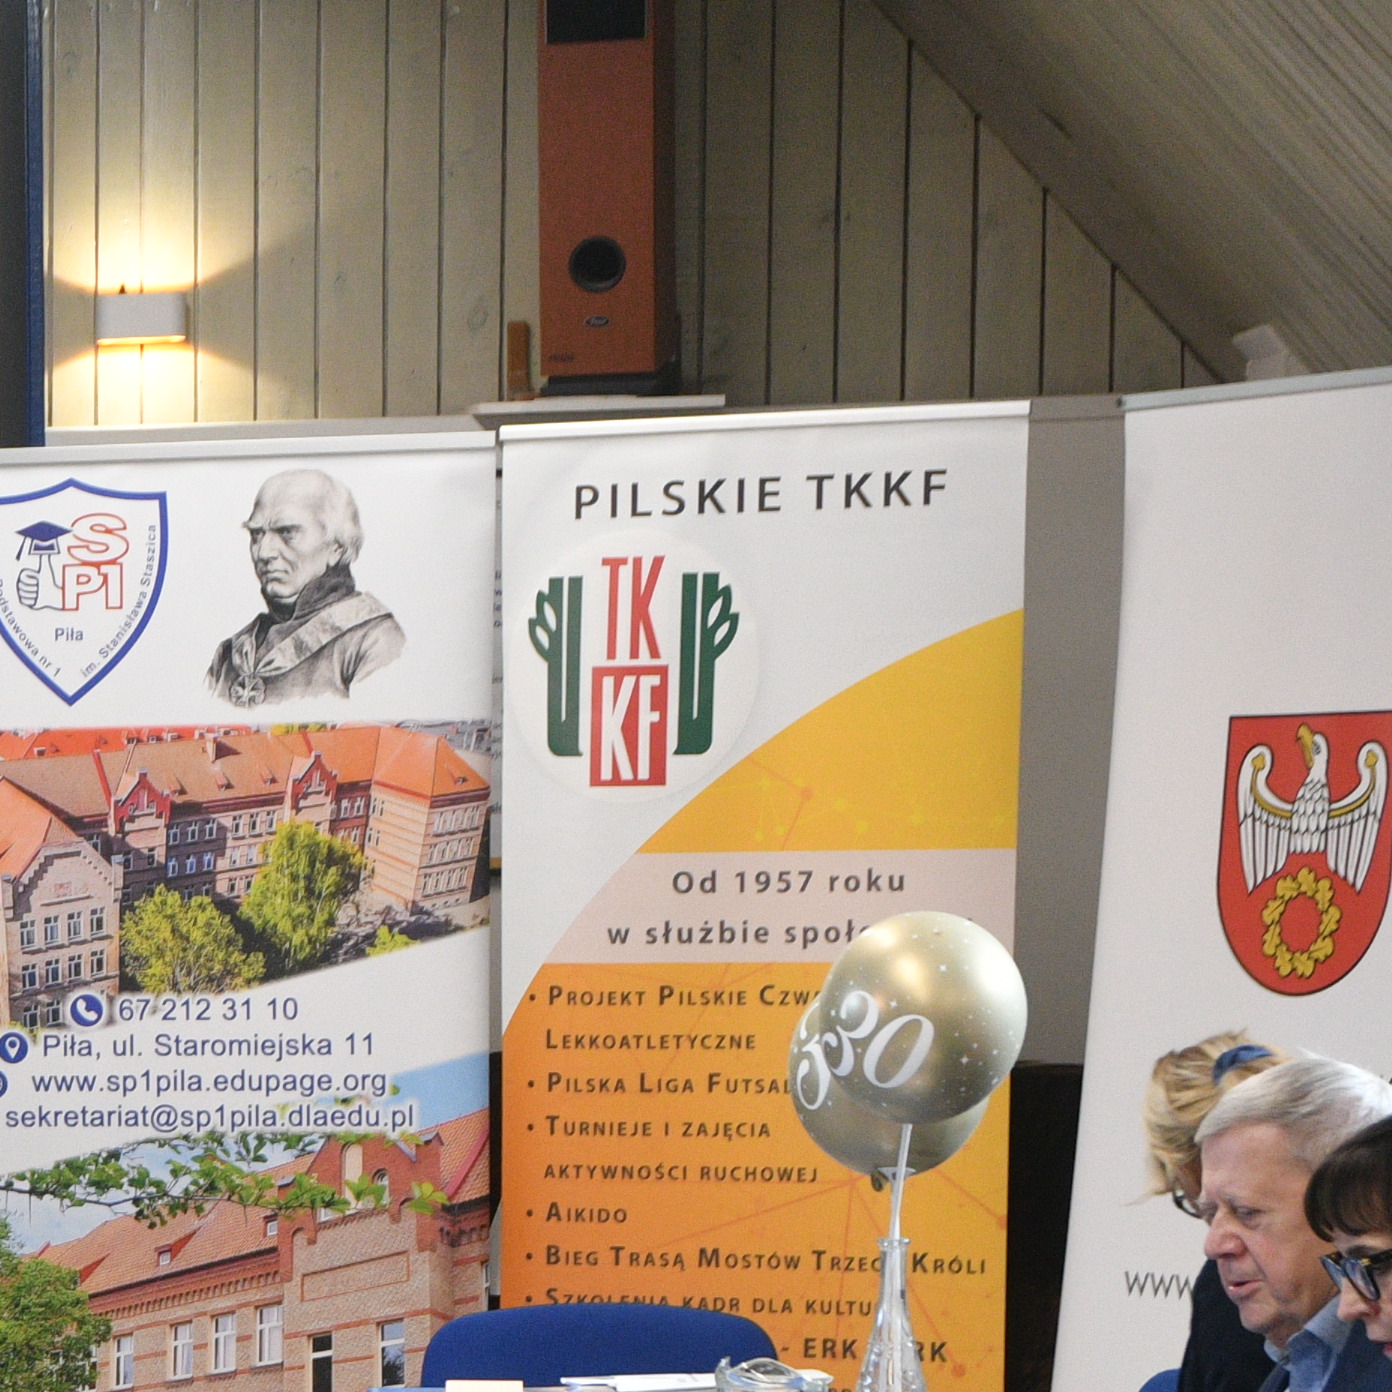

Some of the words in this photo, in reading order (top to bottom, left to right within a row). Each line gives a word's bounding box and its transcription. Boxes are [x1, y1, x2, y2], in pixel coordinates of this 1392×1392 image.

[574, 476, 783, 520] PILSKIE
[806, 469, 949, 510] TKKF
[67, 513, 130, 564] S
[81, 662, 101, 678] im.
[99, 591, 147, 658] Stanisława
[140, 525, 156, 587] Staszica
[601, 555, 666, 660] TK
[55, 627, 84, 642] Piła
[39, 655, 52, 669] nr
[600, 673, 662, 782] KF
[672, 870, 717, 894] Od
[735, 870, 813, 893] 1957
[828, 867, 907, 893] roku
[607, 927, 630, 944] w
[646, 920, 769, 944] służbie
[785, 919, 871, 949] społ
[119, 999, 151, 1021] 67
[161, 998, 211, 1021] 212
[222, 998, 251, 1020] 31
[268, 997, 299, 1020] 10
[549, 985, 646, 1006] PROJEKT
[659, 985, 747, 1006] PILSKIE
[759, 985, 822, 1006] CZW
[43, 1035, 101, 1060] Piła,
[113, 1034, 142, 1057] ul.
[154, 1033, 333, 1062] Staromiejska
[345, 1033, 374, 1056] 11
[546, 1029, 756, 1050] LEKKOATLETYCZNE
[821, 990, 935, 1089] 30
[31, 1070, 387, 1097] www.sp1pila.edupage.org
[547, 1072, 626, 1093] PILSKA
[639, 1072, 694, 1093] LIGA
[6, 1104, 414, 1133] sekretariat@sp1pila.dlaedu.pl
[546, 1115, 652, 1137] TURNIEJE
[544, 1162, 688, 1180] AKTYWNOŚCI
[700, 1166, 818, 1183] RUCHOWEJ
[546, 1202, 628, 1223] AIKIDO
[546, 1245, 599, 1266] BIEG
[610, 1246, 686, 1271] TRASĄ
[698, 1247, 801, 1270] MOSTÓW
[812, 1250, 884, 1273] TRZEC
[912, 1253, 986, 1274] KRÓLI
[1124, 1271, 1192, 1299] www
[753, 1298, 793, 1314] DLA
[805, 1299, 872, 1316] KULTU
